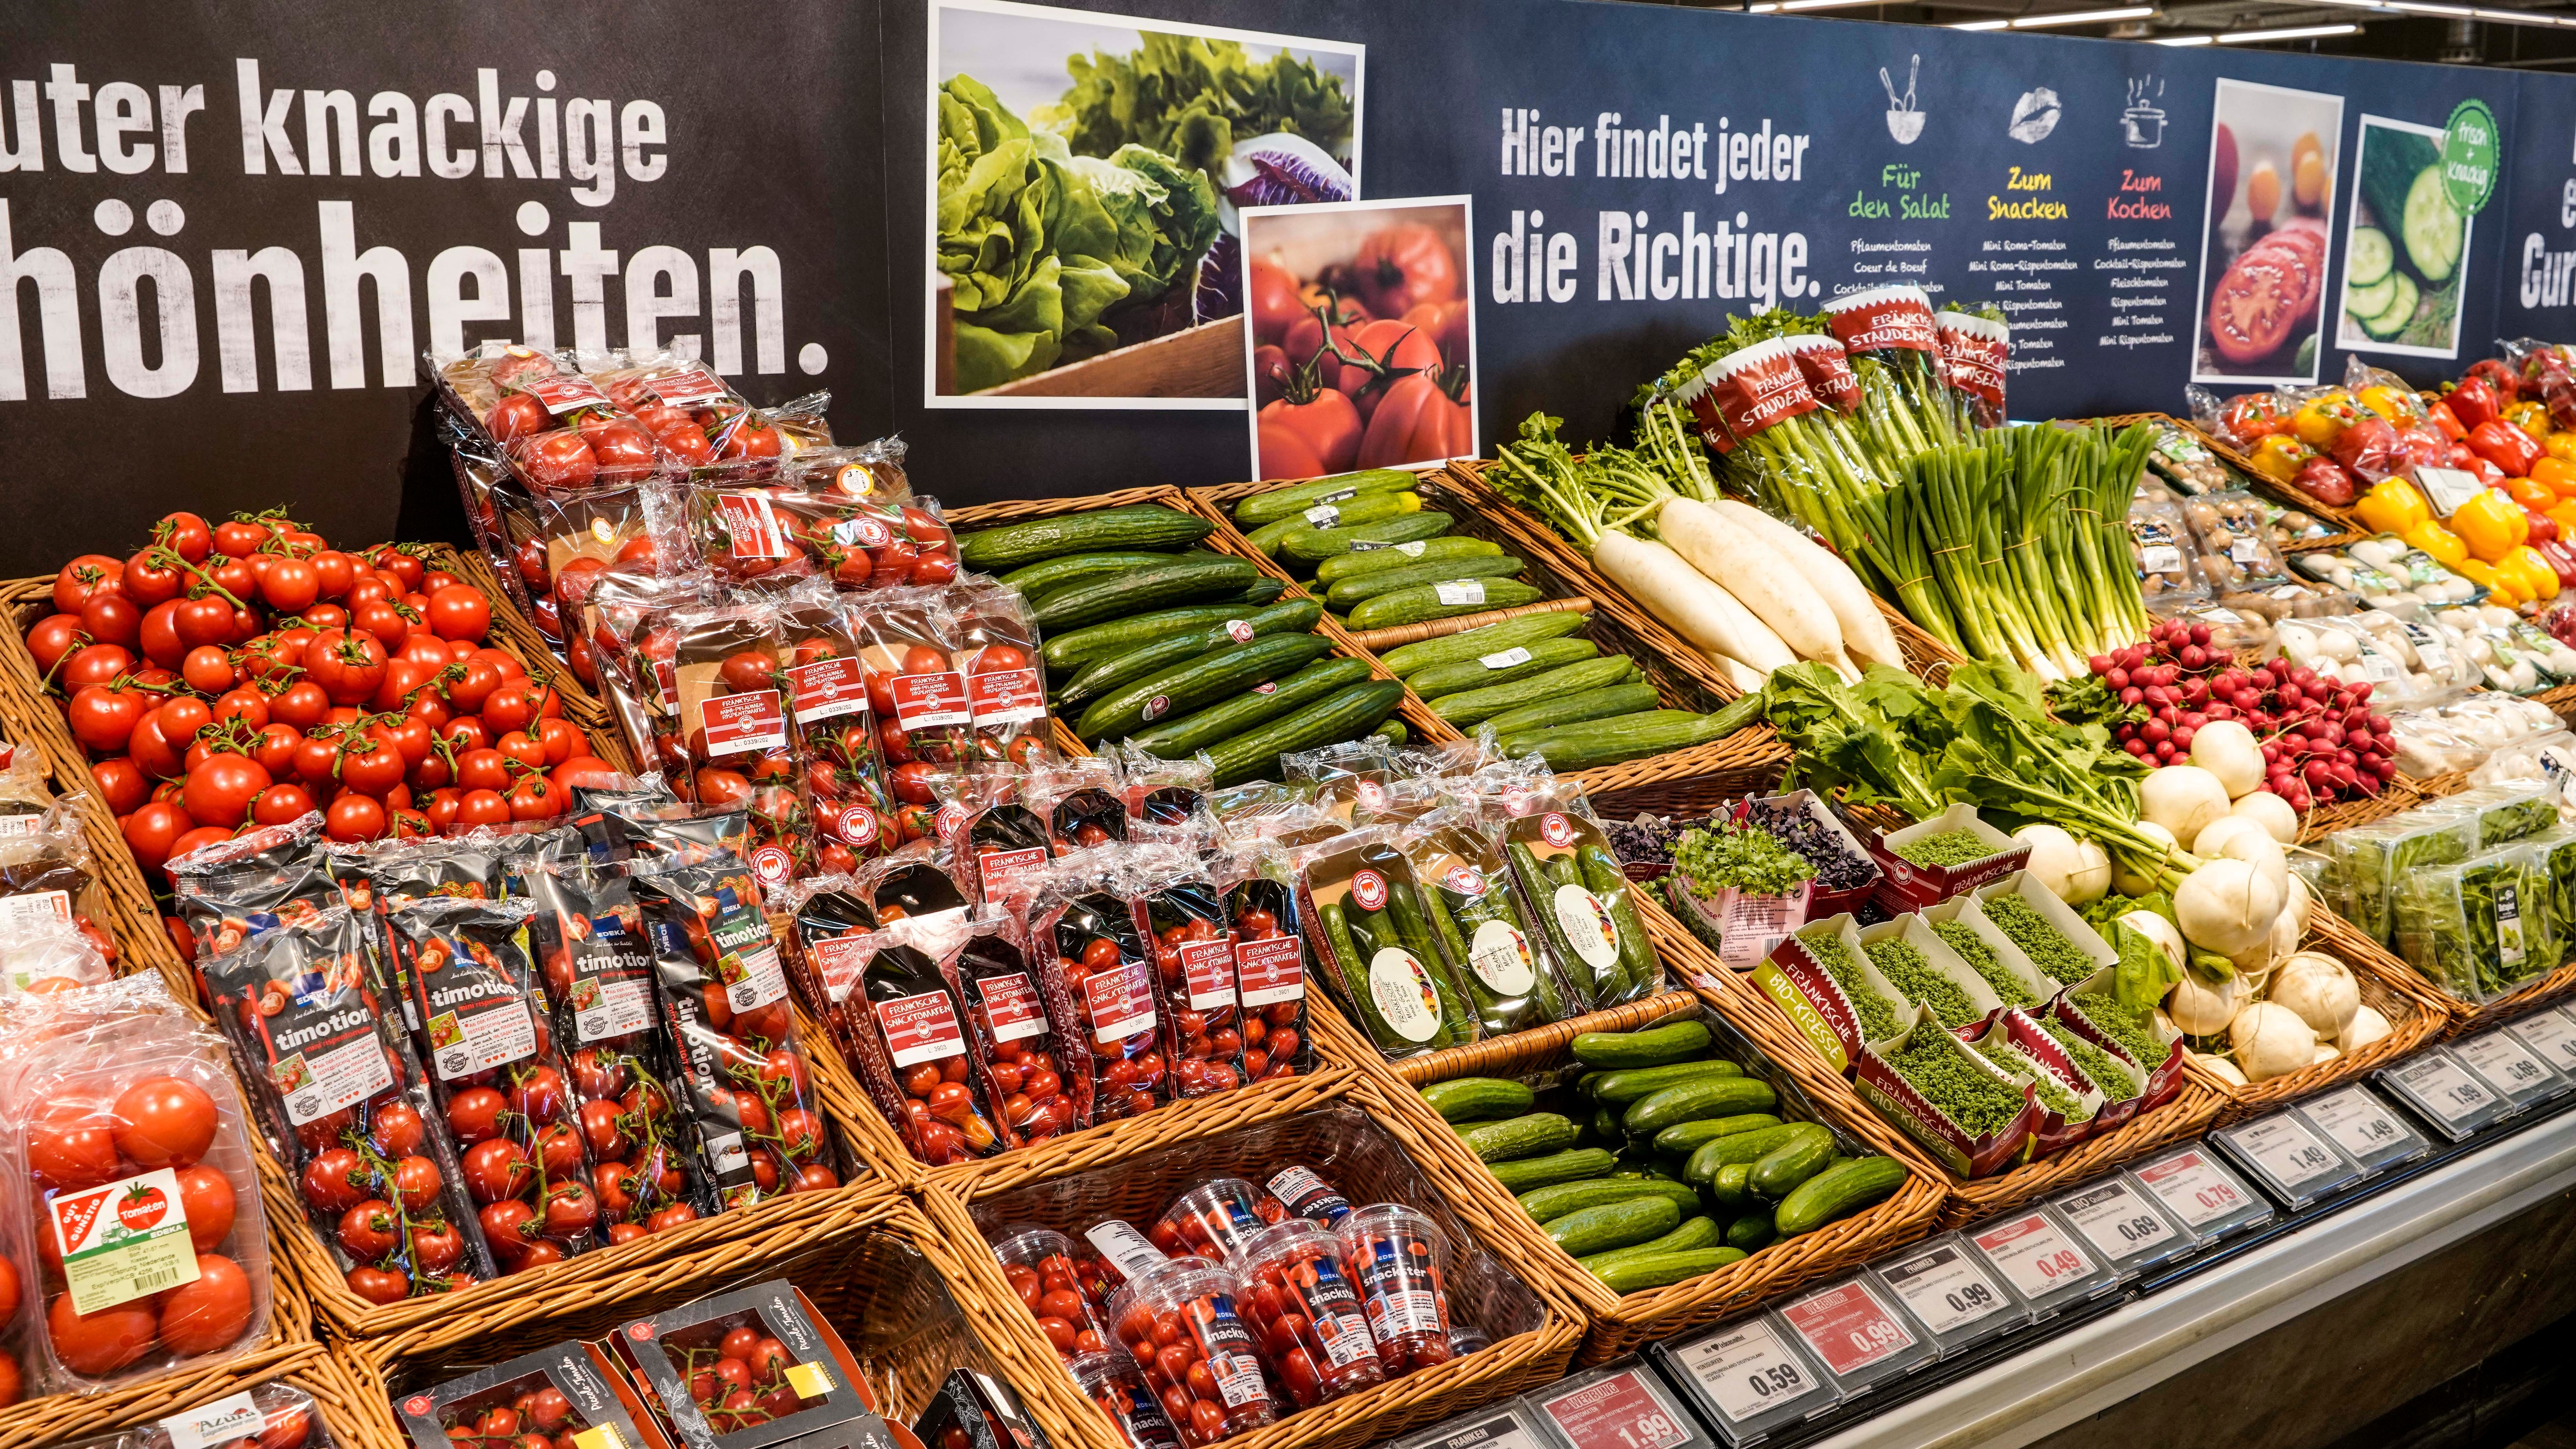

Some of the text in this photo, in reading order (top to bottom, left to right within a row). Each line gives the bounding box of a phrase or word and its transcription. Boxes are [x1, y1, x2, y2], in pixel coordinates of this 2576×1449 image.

[0, 58, 667, 207] uter knackige
[1502, 108, 1809, 194] Hier findet jeder
[1883, 164, 1921, 189] Für
[2008, 166, 2051, 191] Zum
[2121, 169, 2161, 191] Zum
[1849, 191, 1950, 219] den Salat
[1988, 196, 2068, 220] Snacken
[2107, 196, 2172, 219] Kochen
[1851, 238, 1931, 254] Pflaumentomaten
[1982, 239, 2066, 251] Mini Roma-Tomaten
[2107, 237, 2176, 252] Pflaumentomaten
[1493, 210, 1821, 317] die Richtige.
[1854, 259, 1927, 274] Coeur de Boeuf
[1968, 259, 2078, 276] Mini Roma-Rispentomaten
[2094, 258, 2187, 274] Cocktail-Rispentomaten
[2520, 232, 2576, 309] Gur
[1995, 279, 2051, 291] Mini Tomaten
[2110, 276, 2168, 288] Fleischtomaten
[0, 197, 828, 401] hönheiten.
[2003, 298, 2062, 316] Rispentomaten
[2111, 295, 2167, 313] Rispentomaten
[2009, 317, 2068, 330] aumentomaten
[2112, 314, 2164, 326] Mini Tomaten
[2018, 337, 2054, 349] Tomaten
[2099, 332, 2174, 350] Mini Rispentomaten
[2006, 356, 2065, 375] Rispentomaten
[1740, 385, 1812, 425] STAUDENS
[804, 670, 845, 683] MINI-PFLAUMEN-
[805, 662, 841, 675] FRÄNKISCHE
[984, 673, 1018, 683] FRÄNKISCHE
[806, 674, 846, 688] RISPENTOMATEN
[910, 683, 948, 692] MINI-PFLAUMEN-
[911, 675, 944, 685] FRÄNKISCHE
[982, 680, 1022, 690] MINI-PFLAUMEN-
[985, 684, 1023, 694] RISPENTOMATEN
[722, 694, 761, 706] FRÄNKISCHE
[912, 687, 949, 696] RISPENTOMATEN
[720, 703, 765, 715] MINI-PFLAUMEN-
[722, 707, 765, 720] RISPENTOMATEN
[829, 704, 852, 713] 0339/202
[990, 852, 1038, 867] FRÄNKISCHE
[1953, 861, 2015, 894] FRÄNKISCHE
[723, 904, 741, 914] EDEKA
[659, 924, 671, 953] EDEKA
[716, 923, 771, 948] timotion
[1192, 944, 1227, 959] FRÄNKISCHE
[1246, 941, 1292, 957] FRÄNKISCHE
[1304, 896, 1352, 1003] FRÄNKISCHE MINIGURKEN
[1188, 954, 1232, 972] SNACKTOMATEN
[1241, 951, 1298, 969] SNACKTOMATEN
[986, 978, 1022, 992] FRÄNKISCHE
[1095, 967, 1140, 991] FRÄNKISCHE
[432, 980, 519, 1007] timotion
[987, 986, 1033, 1003] SNACKTOMATEN
[1091, 977, 1147, 1004] SNACKTOMATEN
[889, 996, 940, 1015] FRÄNKISCHE
[1786, 963, 1853, 1043] FRÄNKISCHE
[886, 1004, 951, 1028] SNACKTOMATEN
[1404, 1007, 1413, 1019] Mini
[1769, 973, 1842, 1061] BIO-KRESSE
[276, 1008, 370, 1050] timotion
[2448, 1084, 2482, 1105] 1.99
[1876, 1077, 1955, 1143] FRÄNKISCHE
[1870, 1088, 1957, 1160] BIO-KRESSE
[2359, 1119, 2394, 1141] 1.49
[2290, 1145, 2327, 1170] 1.49
[2090, 1189, 2114, 1203] Qualität
[2195, 1184, 2236, 1208] 0.79
[63, 1203, 78, 1223] GUT
[71, 1198, 100, 1241] GÜNSTIG
[121, 1200, 165, 1220] Tomaten
[150, 1225, 182, 1238] EDEKA
[1991, 1223, 2027, 1240] UNSER TIEFPREIS
[2117, 1216, 2160, 1241] 0.69
[1997, 1248, 2025, 1262] URSPRUNGSLAND
[2037, 1250, 2081, 1277] 0.49
[1904, 1257, 1937, 1274] FRANKEN
[1363, 1267, 1426, 1287] snackster
[1897, 1277, 1922, 1289] SALATGURKEN
[1802, 1291, 1848, 1315] WERBUNG
[1946, 1283, 1992, 1312] 0.99
[773, 1297, 810, 1350] Piccolo-Tomaten
[1799, 1316, 1824, 1328] MINIGURKEN
[1807, 1310, 1863, 1336] URSPRUNGSLAND DEUTSCHLAND
[1850, 1321, 1899, 1352] 0.99
[1696, 1357, 1723, 1371] MINIGURKEN
[1704, 1352, 1764, 1378] URSPRUNGSLAND DEUTSCHLAND
[563, 1356, 602, 1411] Piccolo-Tomaten
[819, 1361, 838, 1388] SELECTION
[1749, 1363, 1800, 1396] 0.59
[1567, 1383, 1619, 1409] WERBUNG
[1562, 1406, 1598, 1424] RISPENTOMATEN
[1569, 1414, 1605, 1432] URSPRUNGSLAND
[1447, 1428, 1488, 1448] FRANKEN
[1572, 1428, 1588, 1437] KLASSE
[1618, 1414, 1673, 1449] 1.99
